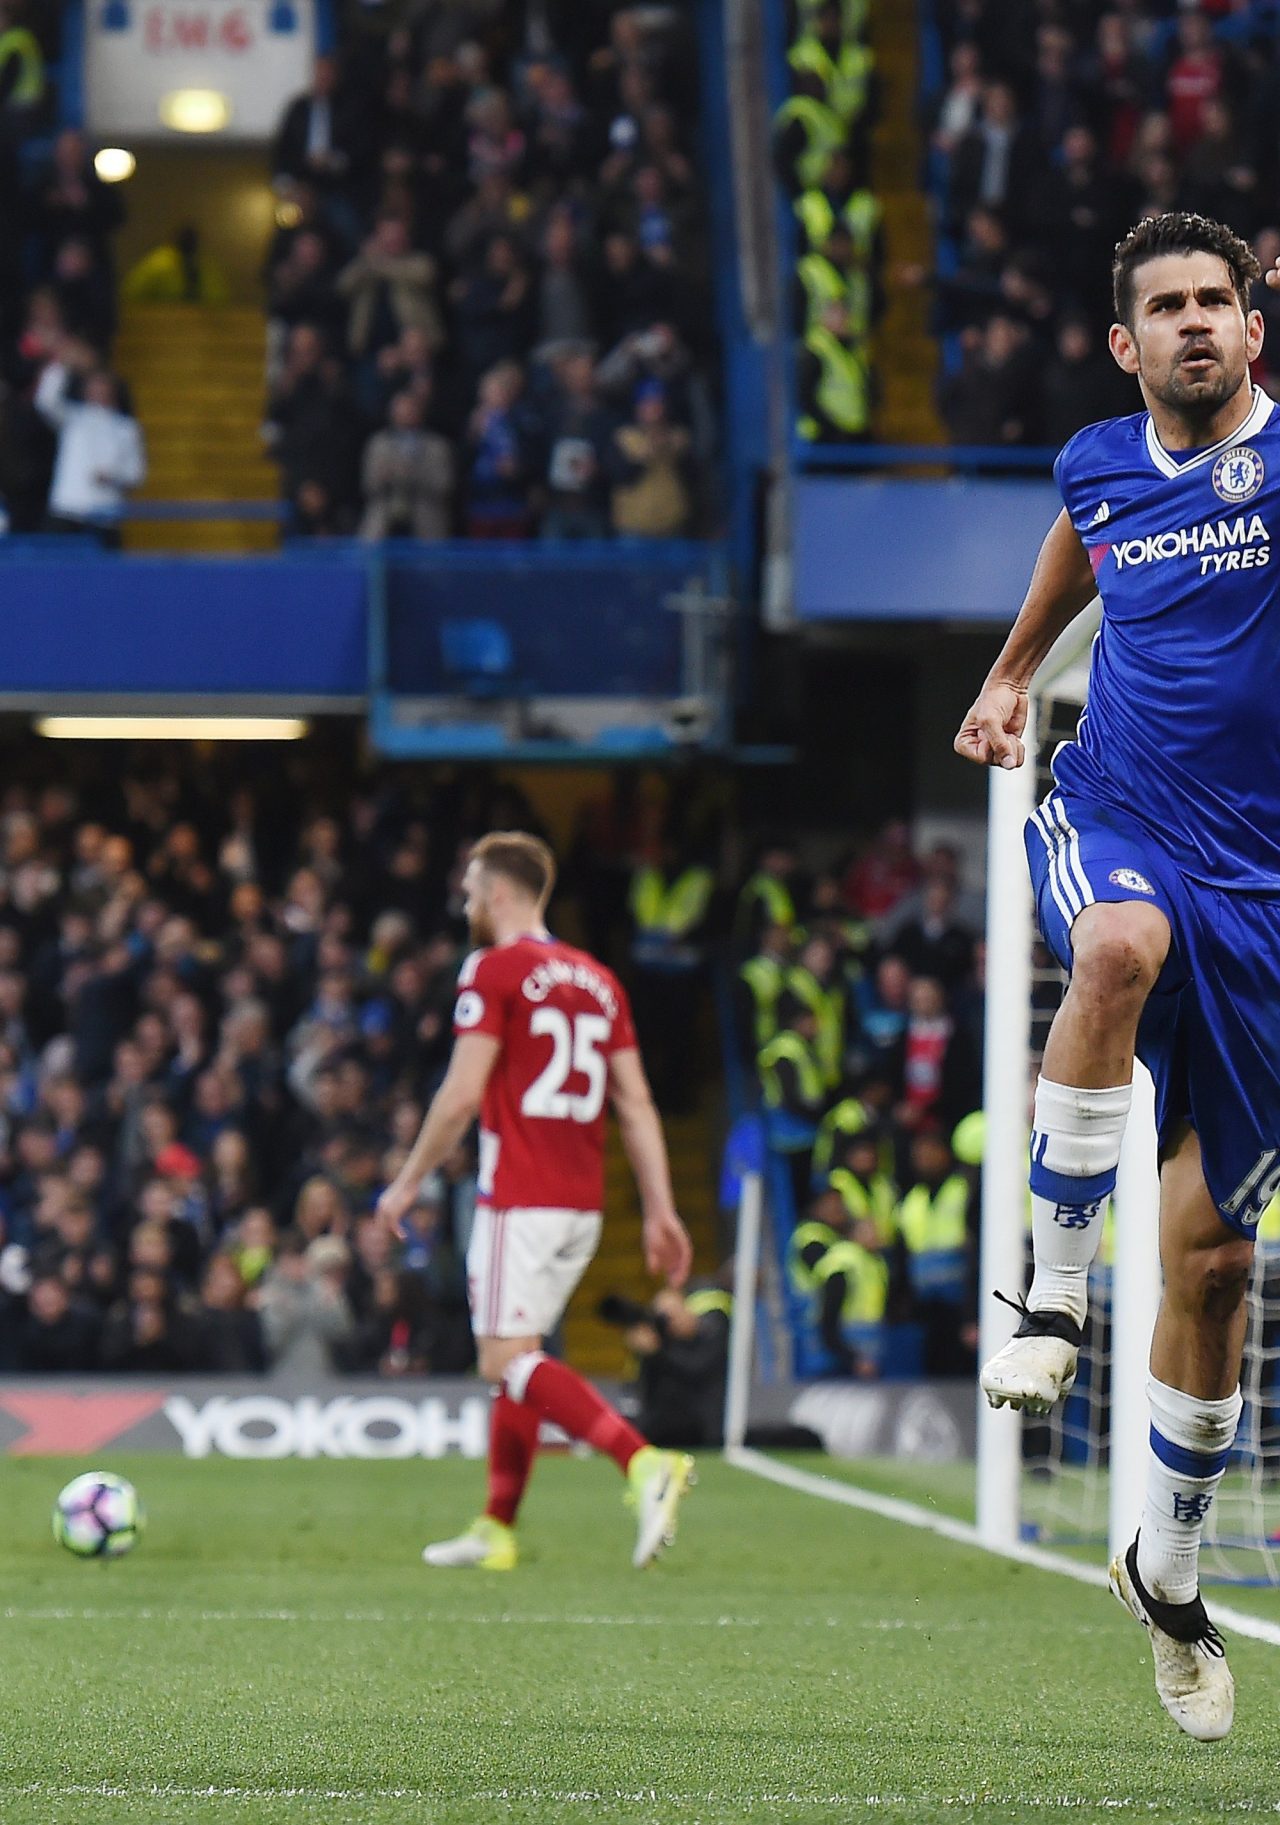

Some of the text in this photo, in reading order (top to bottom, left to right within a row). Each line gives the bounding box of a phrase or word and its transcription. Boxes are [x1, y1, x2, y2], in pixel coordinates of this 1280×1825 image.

[1111, 514, 1271, 569] YOKOHAMA
[1200, 546, 1271, 575] TYRES
[521, 1005, 612, 1123] 25
